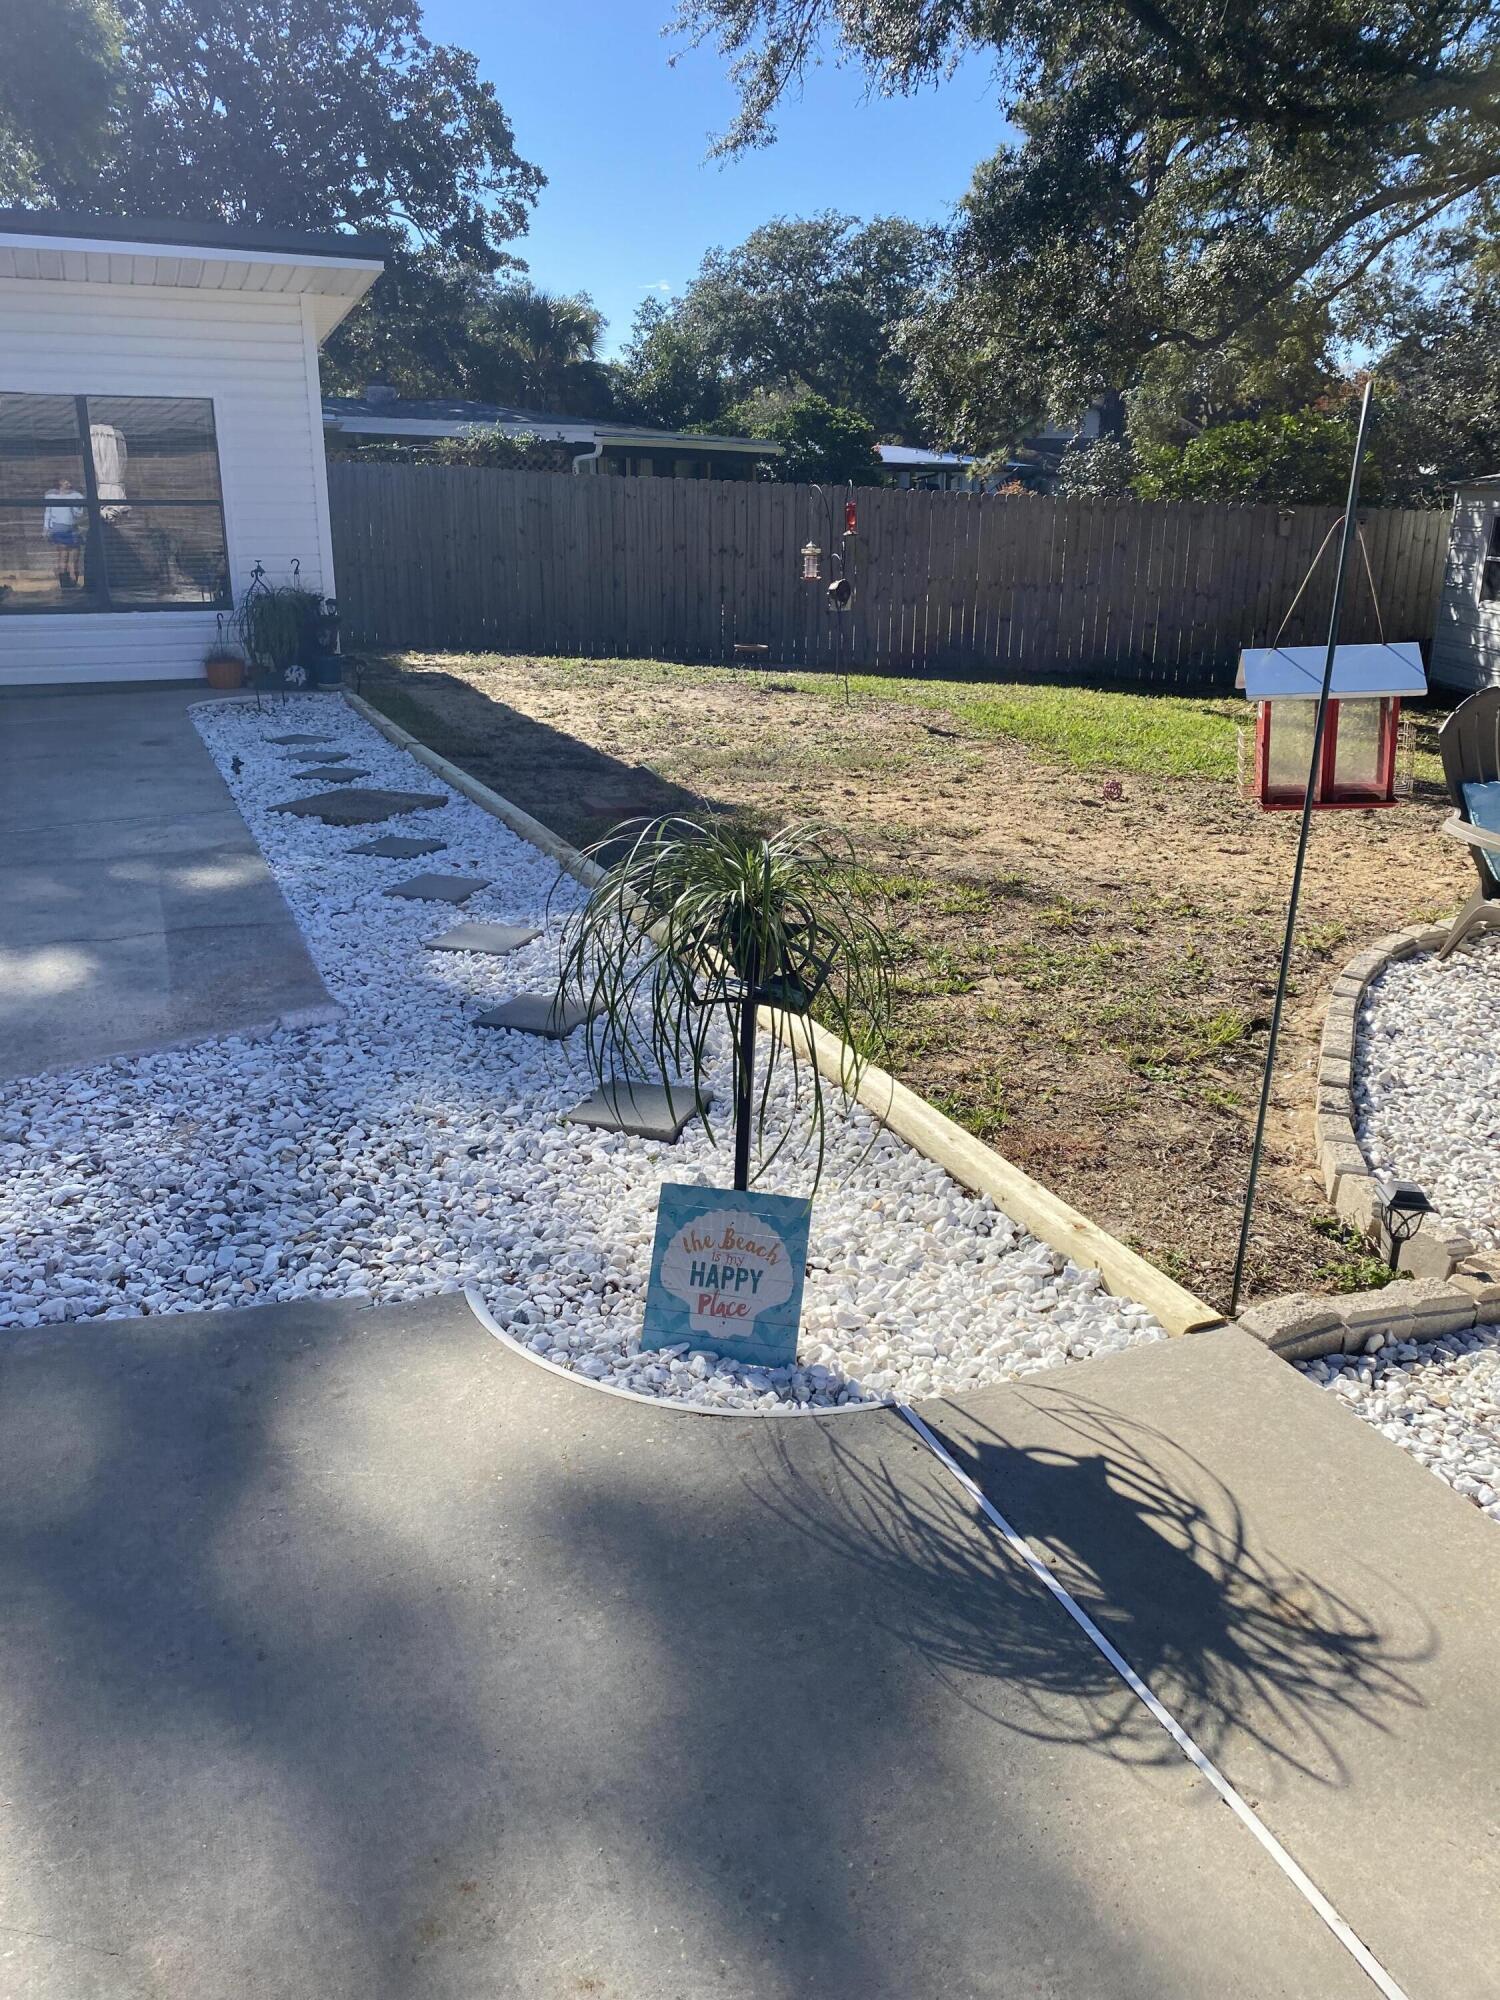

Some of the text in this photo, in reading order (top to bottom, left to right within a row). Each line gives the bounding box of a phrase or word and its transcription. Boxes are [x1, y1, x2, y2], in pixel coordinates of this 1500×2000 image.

[711, 1251, 745, 1267] is my
[718, 1227, 781, 1266] Beach
[689, 1260, 764, 1294] HAPPY
[697, 1289, 751, 1318] Place
